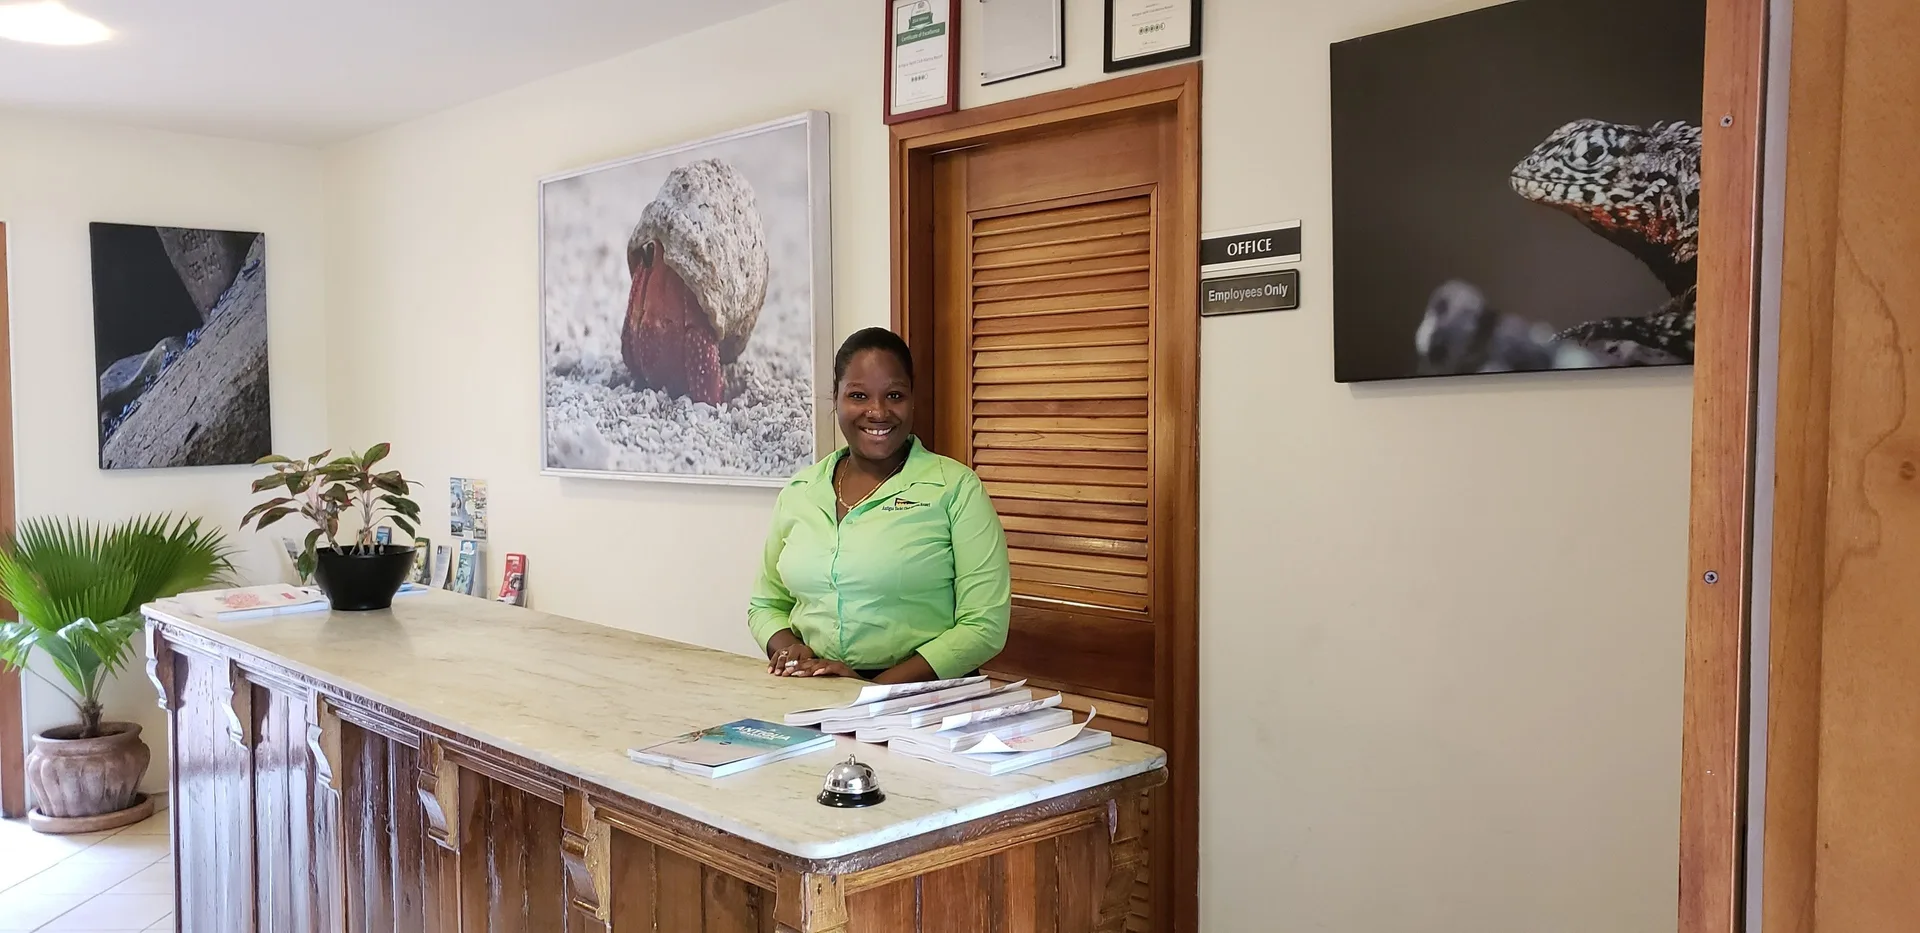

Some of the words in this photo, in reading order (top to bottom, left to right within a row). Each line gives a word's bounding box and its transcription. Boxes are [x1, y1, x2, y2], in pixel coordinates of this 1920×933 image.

[1227, 238, 1272, 256] OFFICE
[1208, 287, 1263, 303] Employees
[1264, 283, 1288, 298] Only
